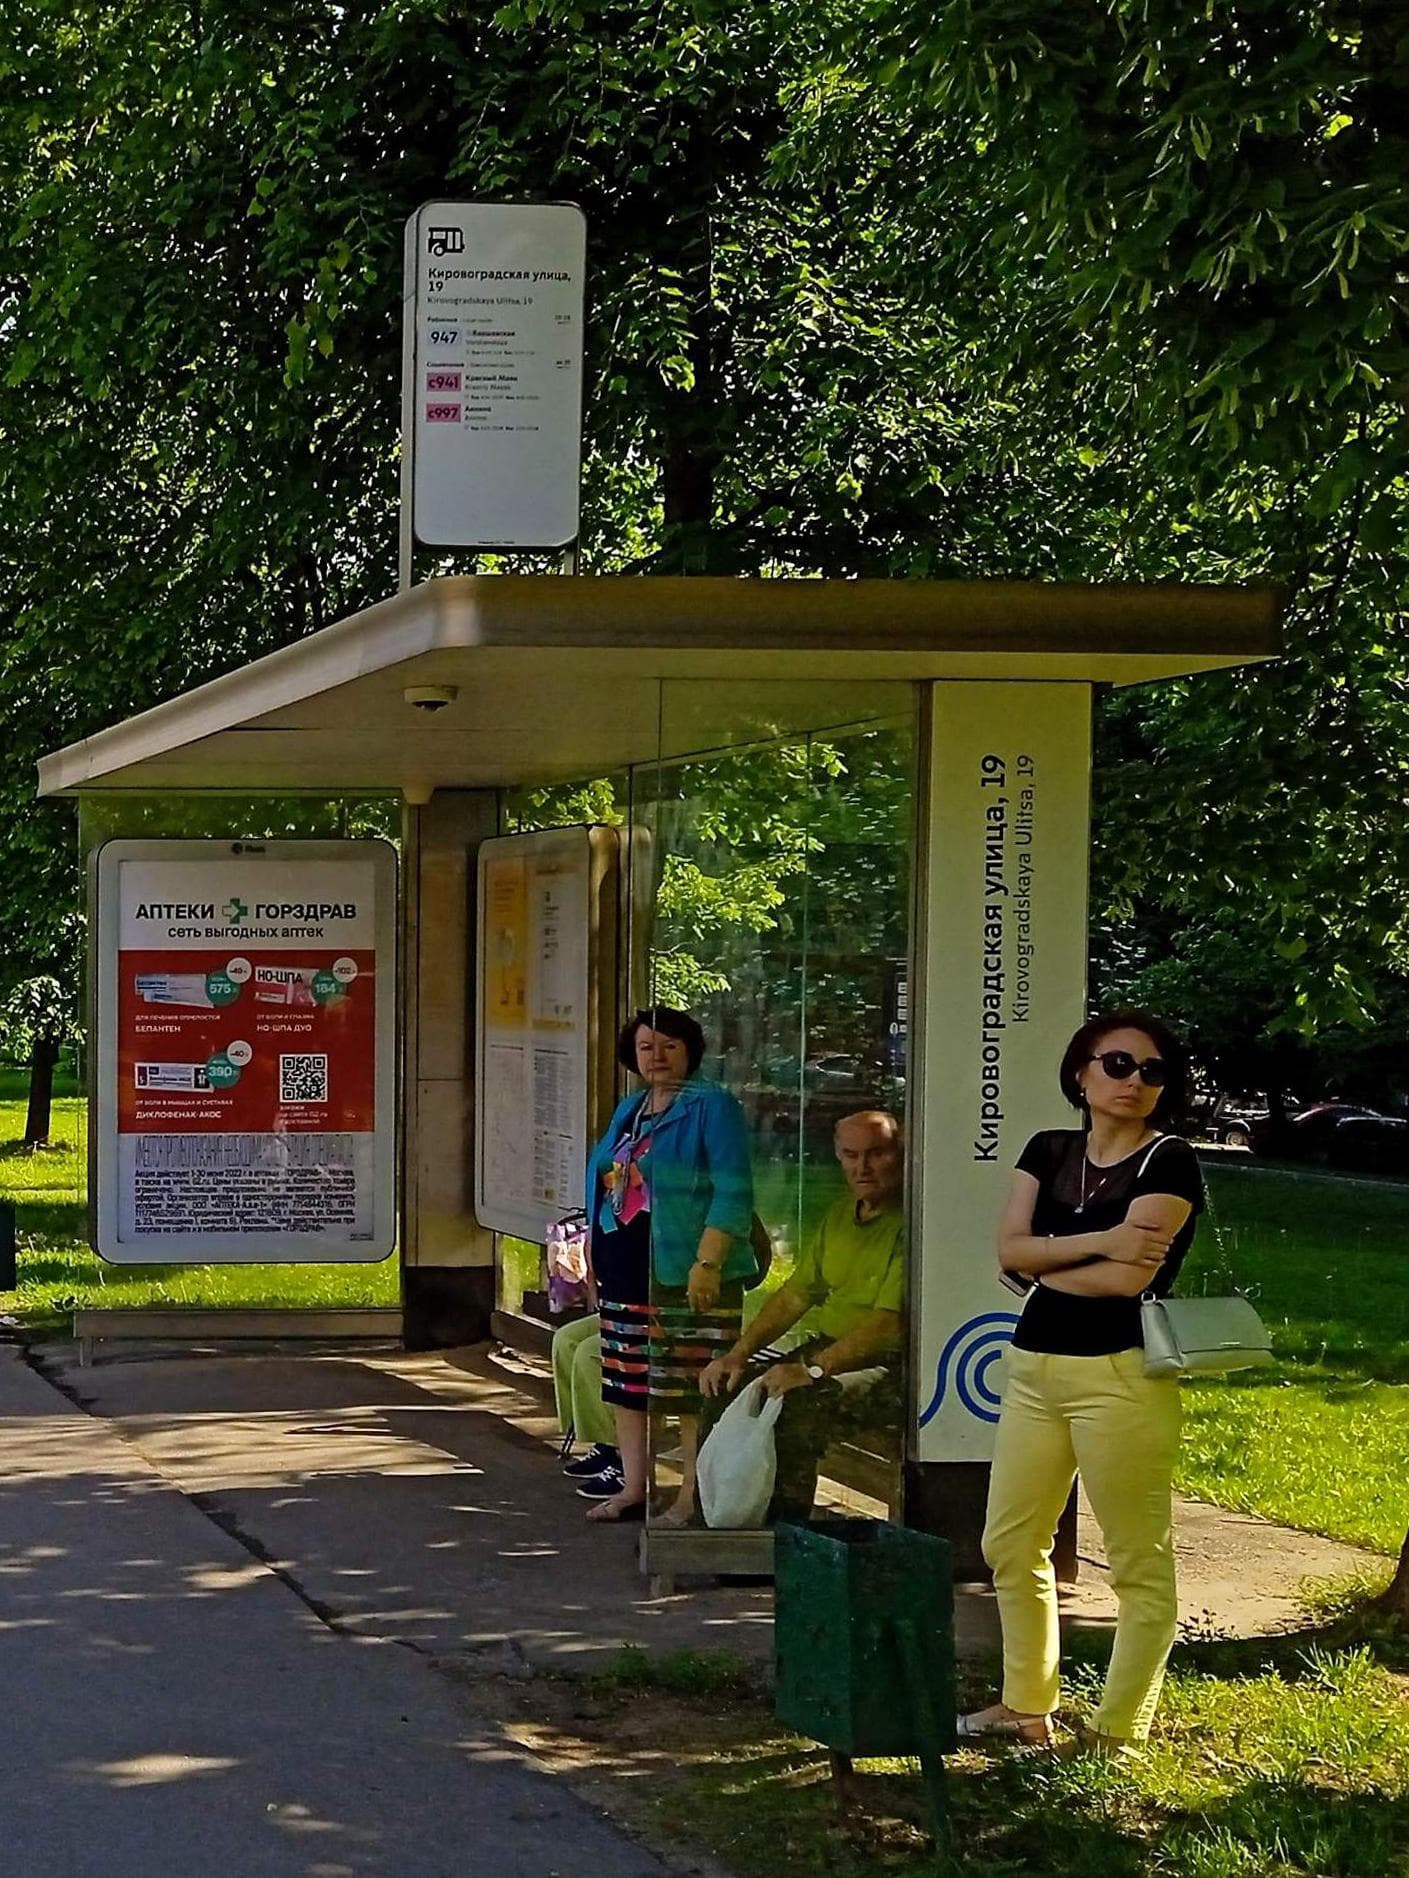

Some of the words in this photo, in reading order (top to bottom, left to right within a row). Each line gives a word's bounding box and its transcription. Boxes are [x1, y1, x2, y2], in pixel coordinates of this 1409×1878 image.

[428, 268, 530, 282] Кировоградская
[533, 270, 572, 283] улица,
[428, 281, 444, 292] 19
[430, 331, 459, 344] 947
[980, 754, 1006, 788] 19
[1016, 754, 1034, 778] 19
[1015, 785, 1035, 845] Ulitsa,
[982, 797, 1009, 896] улица,
[135, 904, 215, 920] АПТЕКИ
[255, 904, 357, 921] ГОРЗДРАВ
[167, 928, 202, 938] сеть
[205, 928, 278, 939] выгодных
[282, 928, 324, 938] аптек
[1012, 853, 1035, 1023] Kirovogradskaya
[257, 969, 303, 984] НО-ШПА
[209, 984, 232, 994] 575
[135, 1025, 181, 1033] БЕПАНТЕН
[973, 905, 1006, 1162] Кировоградская
